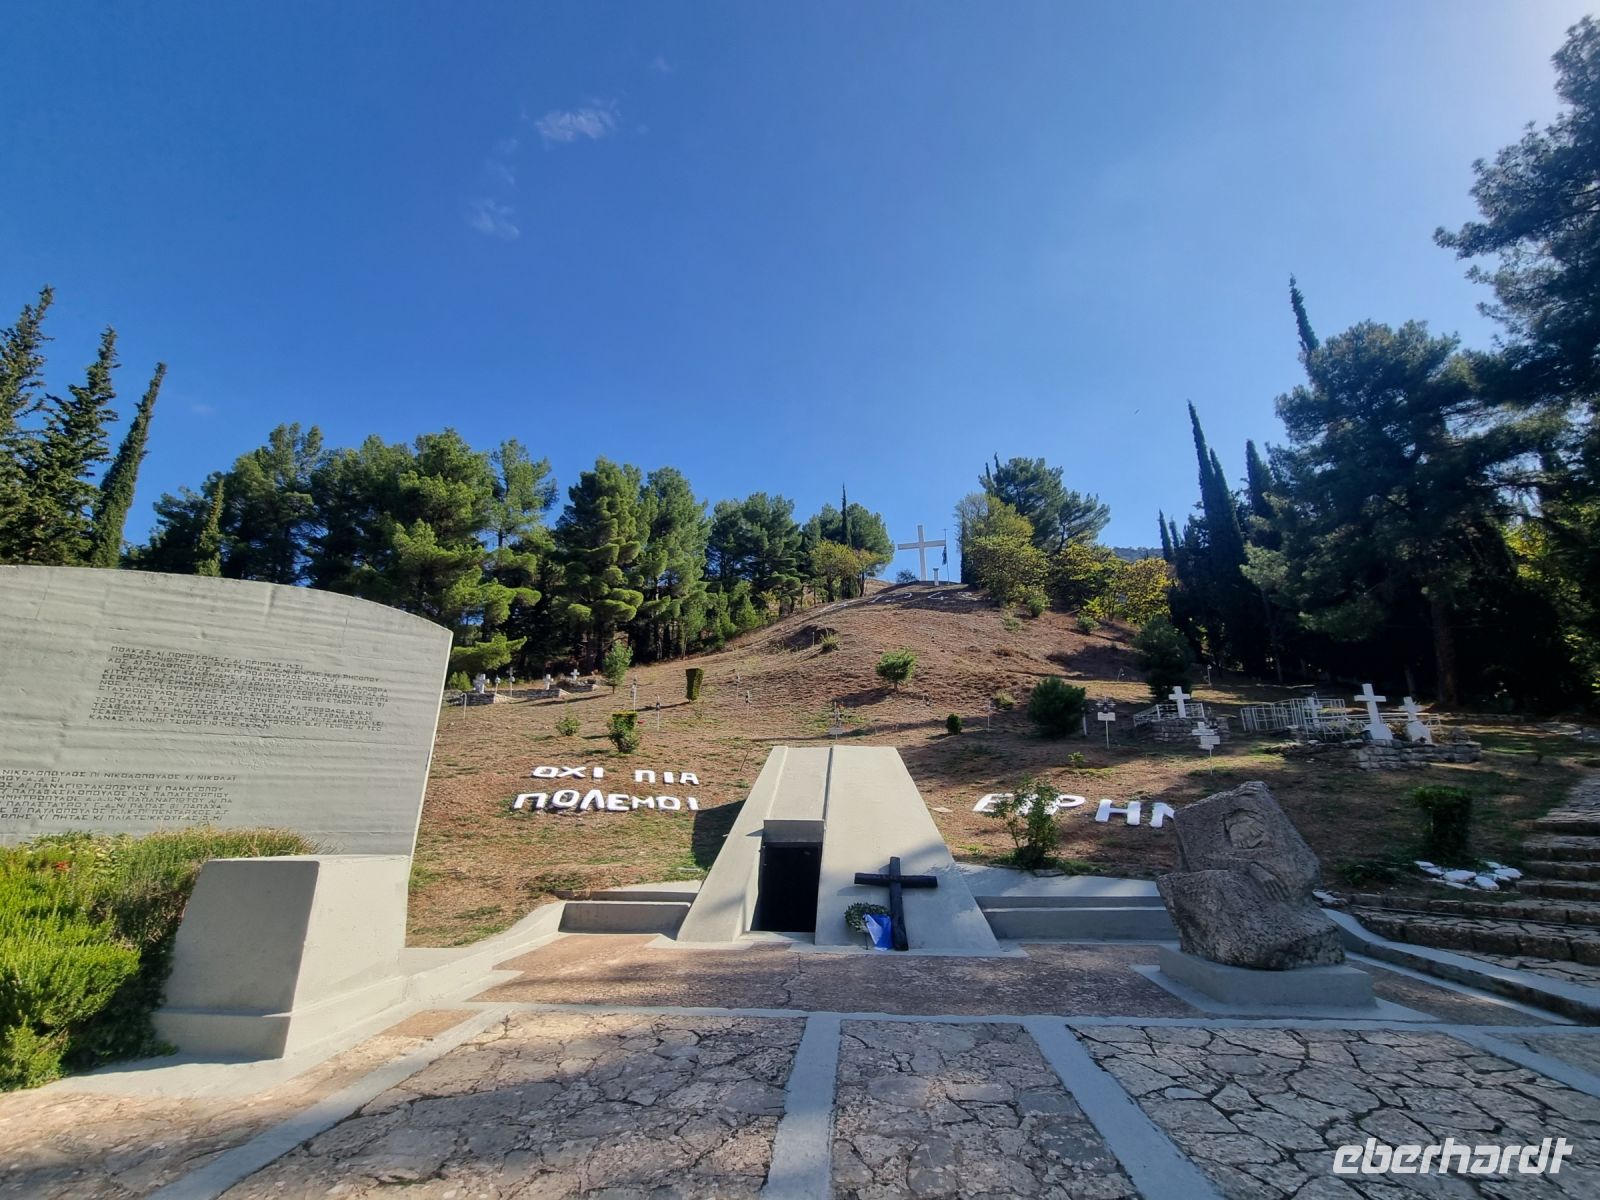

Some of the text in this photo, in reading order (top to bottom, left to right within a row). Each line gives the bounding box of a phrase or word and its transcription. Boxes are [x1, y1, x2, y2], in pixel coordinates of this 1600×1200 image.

[532, 766, 700, 785] ΟΧΙ ΠΙΑ
[512, 789, 700, 812] ΠΟΛΕΜΟΙ
